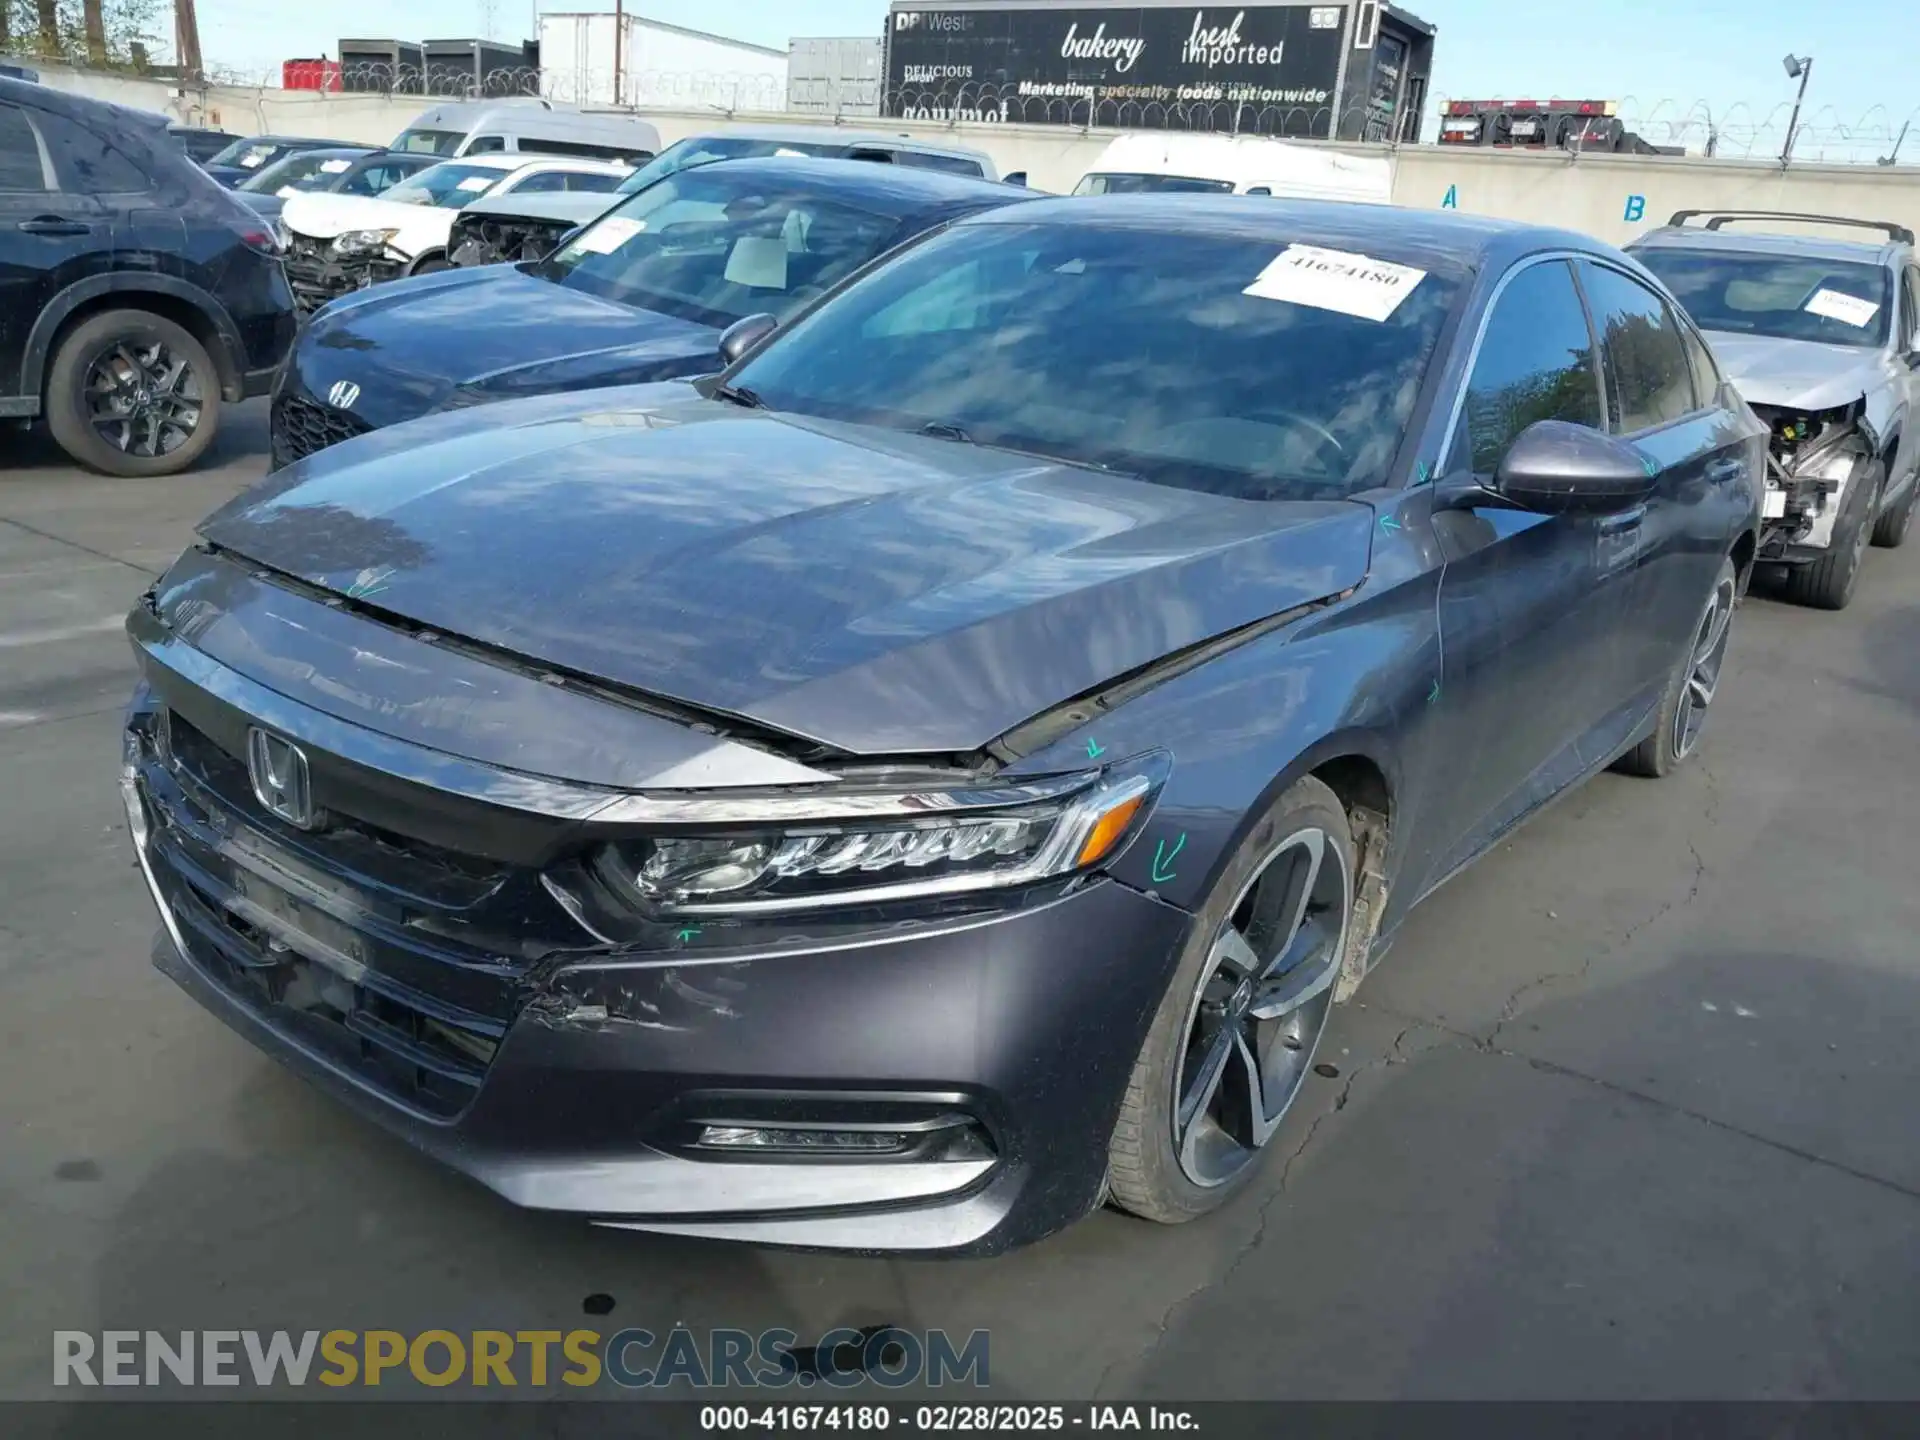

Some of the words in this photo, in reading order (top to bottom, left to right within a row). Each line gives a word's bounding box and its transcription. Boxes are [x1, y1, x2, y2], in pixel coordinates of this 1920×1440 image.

[896, 12, 926, 31] DP
[929, 13, 967, 31] West
[1061, 22, 1147, 72] bakery
[1181, 40, 1284, 69] imported
[904, 65, 973, 78] DELICIOUS
[1018, 81, 1094, 99] Marketing
[1098, 84, 1171, 101] specialty
[1176, 84, 1222, 100] foods
[1227, 86, 1327, 102] nationwide
[1442, 184, 1457, 208] A
[1623, 195, 1646, 222] B
[1289, 257, 1400, 287] 41674180
